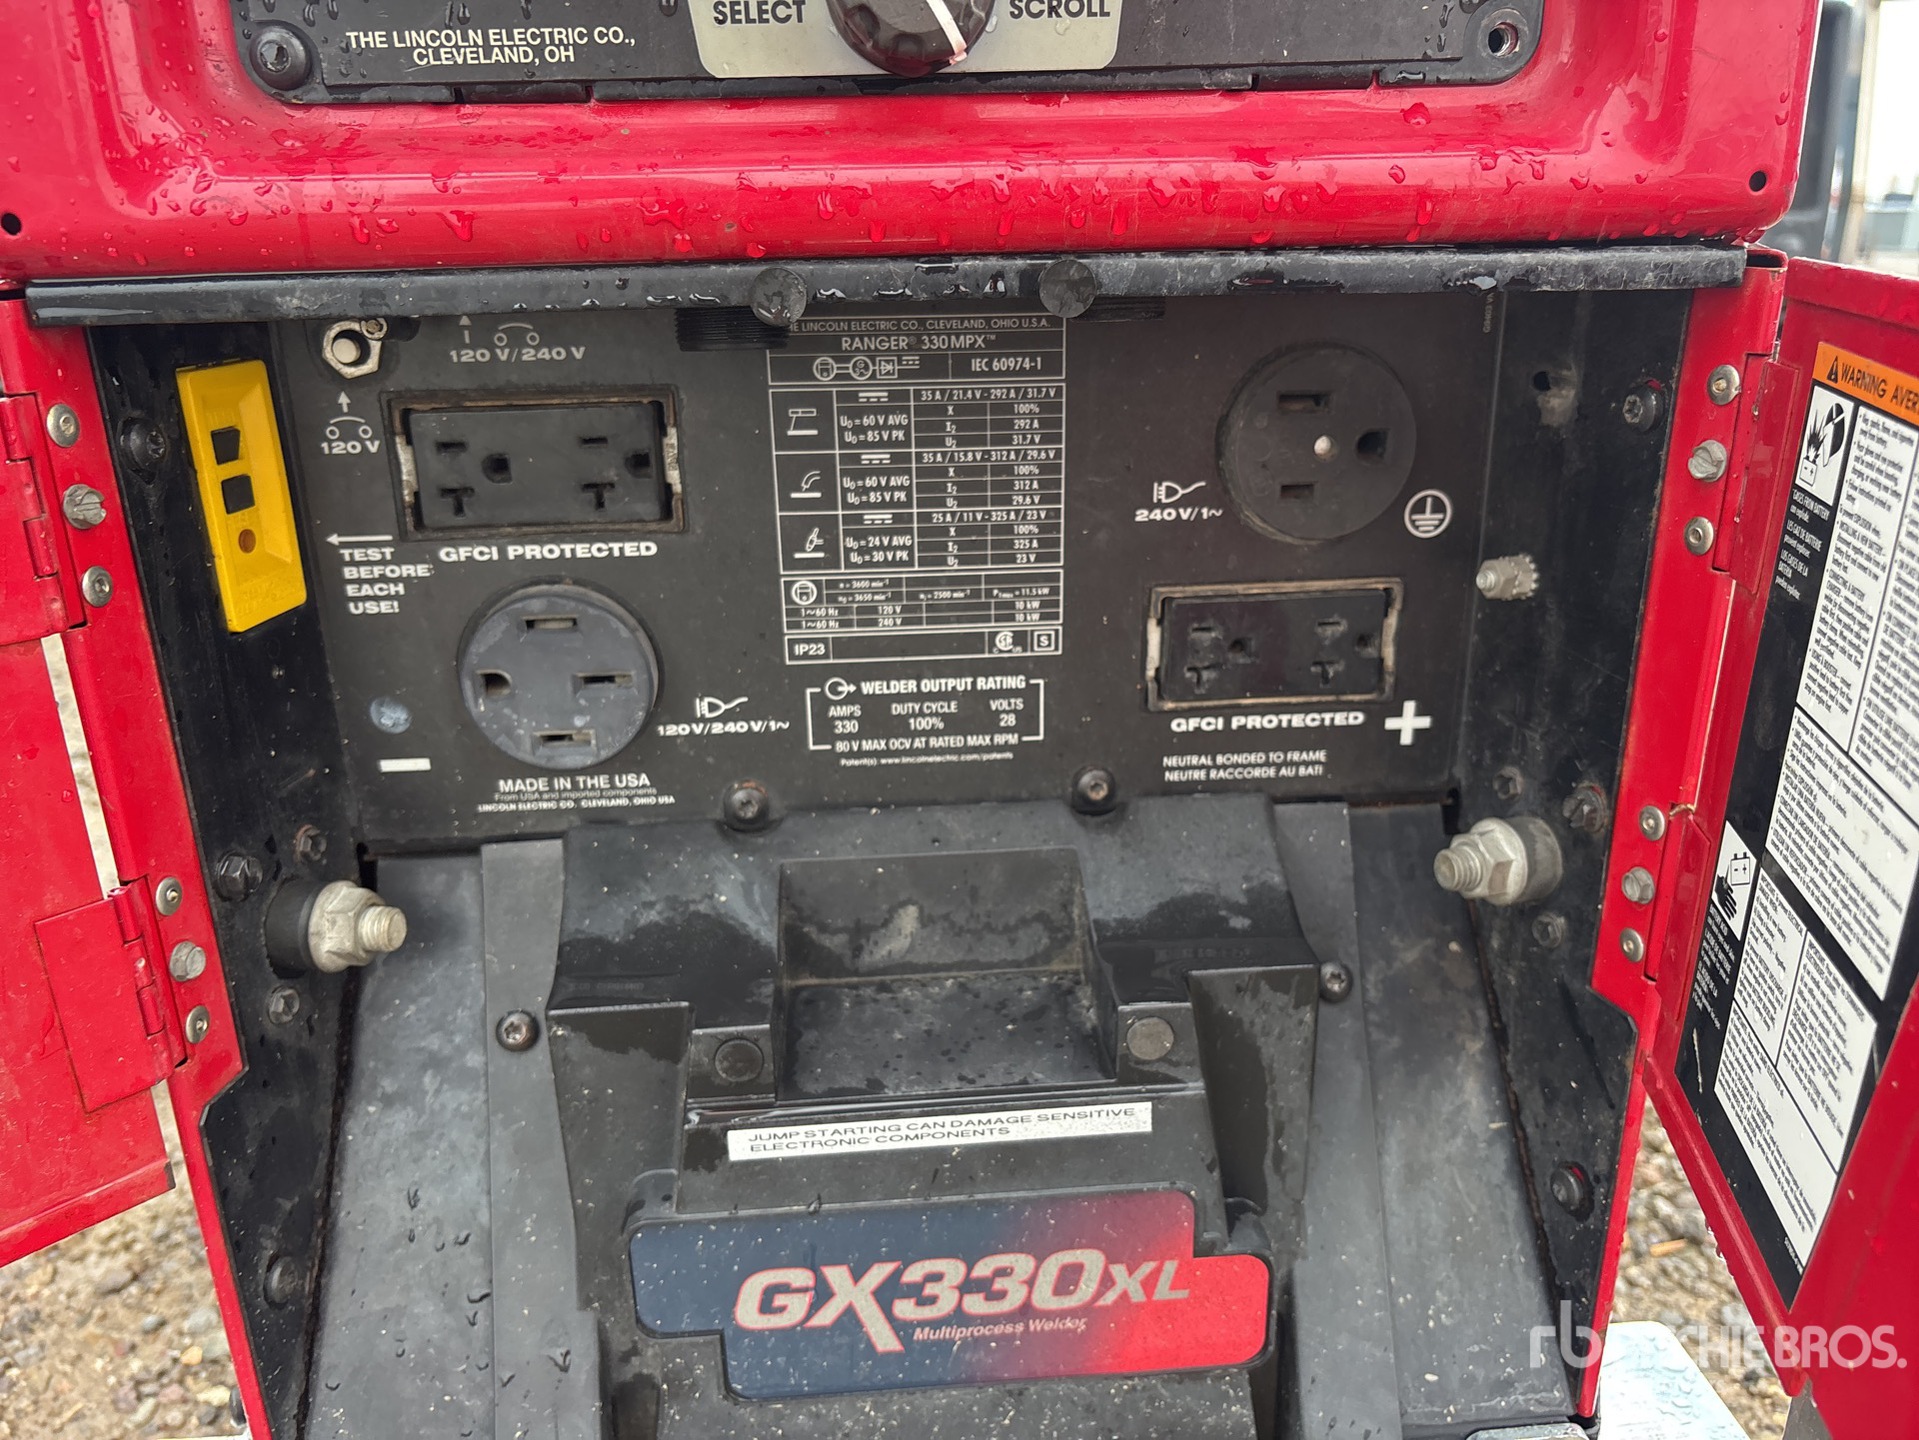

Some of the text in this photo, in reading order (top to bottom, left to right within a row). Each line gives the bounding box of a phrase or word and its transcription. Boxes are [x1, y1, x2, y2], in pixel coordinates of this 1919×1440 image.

[713, 0, 805, 24] SELECT
[1010, 0, 1111, 19] SCROLL
[346, 27, 636, 49] THE LINCOLN ELECTRIC CO.,
[413, 45, 574, 66] CLEVELAND, OH
[802, 321, 848, 332] LINCOLN
[851, 320, 898, 331] ELECTRIC
[926, 319, 988, 330] CLEVELAND,
[992, 318, 1020, 329] OHIO
[1023, 318, 1051, 328] U.S.A.
[450, 349, 491, 363] 120
[972, 357, 1041, 372] IEC 60974-1
[1840, 362, 1888, 399] WARNING
[921, 387, 1056, 401] 35 A 21.4 V 292 A 31.7 V
[1014, 404, 1040, 414] 100%
[888, 413, 909, 426] AVG
[1014, 418, 1040, 430] 292 A
[892, 430, 905, 442] PK
[1012, 434, 1041, 446] 31.7 V
[321, 440, 380, 455] 120 V
[922, 449, 1056, 463] 35 A 15.8 V 312 A 29.6 V
[1014, 465, 1040, 476] 100%
[890, 475, 910, 487] AVG
[1013, 480, 1039, 491] 312 A
[893, 491, 907, 502] PK
[1012, 495, 1041, 506] 29.6 V
[932, 510, 1047, 523] 25 A 11 V 325 A 23 V
[1013, 525, 1039, 535] 100%
[892, 535, 912, 547] AVG
[1013, 539, 1039, 550] 325 A
[340, 547, 394, 562] TEST
[439, 541, 658, 563] GFCI PROTECTED
[896, 550, 909, 562] PK
[1016, 553, 1037, 564] 23 V
[344, 564, 430, 580] BEFORE
[346, 582, 405, 597] EACH
[349, 600, 400, 615] USE!
[878, 606, 894, 615] 120
[878, 618, 894, 628] 240
[794, 643, 826, 656] IP23
[860, 675, 1026, 695] WELDER OUTPUT RATING
[828, 705, 861, 718] AMPS
[891, 701, 958, 715] DUTY CYCLE
[989, 698, 1024, 711] VOLTS
[834, 720, 859, 734] 330
[908, 717, 944, 731] 100%
[999, 714, 1017, 727] 28
[1170, 712, 1365, 733] GFCI PROTECTED
[835, 732, 1019, 753] 80 MAX OCV AT RATED MAX RPM
[1163, 750, 1327, 768] NEUTRAL BONDED TO FRAME
[1164, 764, 1323, 782] NEUTRE RACCORDE AU BATI
[499, 773, 651, 793] MADE IN THE USA
[520, 792, 540, 801] USA
[542, 791, 559, 799] and
[478, 803, 517, 813] LINCOLN
[518, 800, 557, 811] ELECTRIC
[633, 796, 657, 806] OHIO
[658, 795, 675, 805] USA
[748, 1107, 1136, 1143] JUMP STARTING CAN DAMAGE SENSITIVE
[749, 1127, 1011, 1153] ELECTRONIC COMPONENTS
[913, 1316, 1087, 1342] Multiprocess Welder
